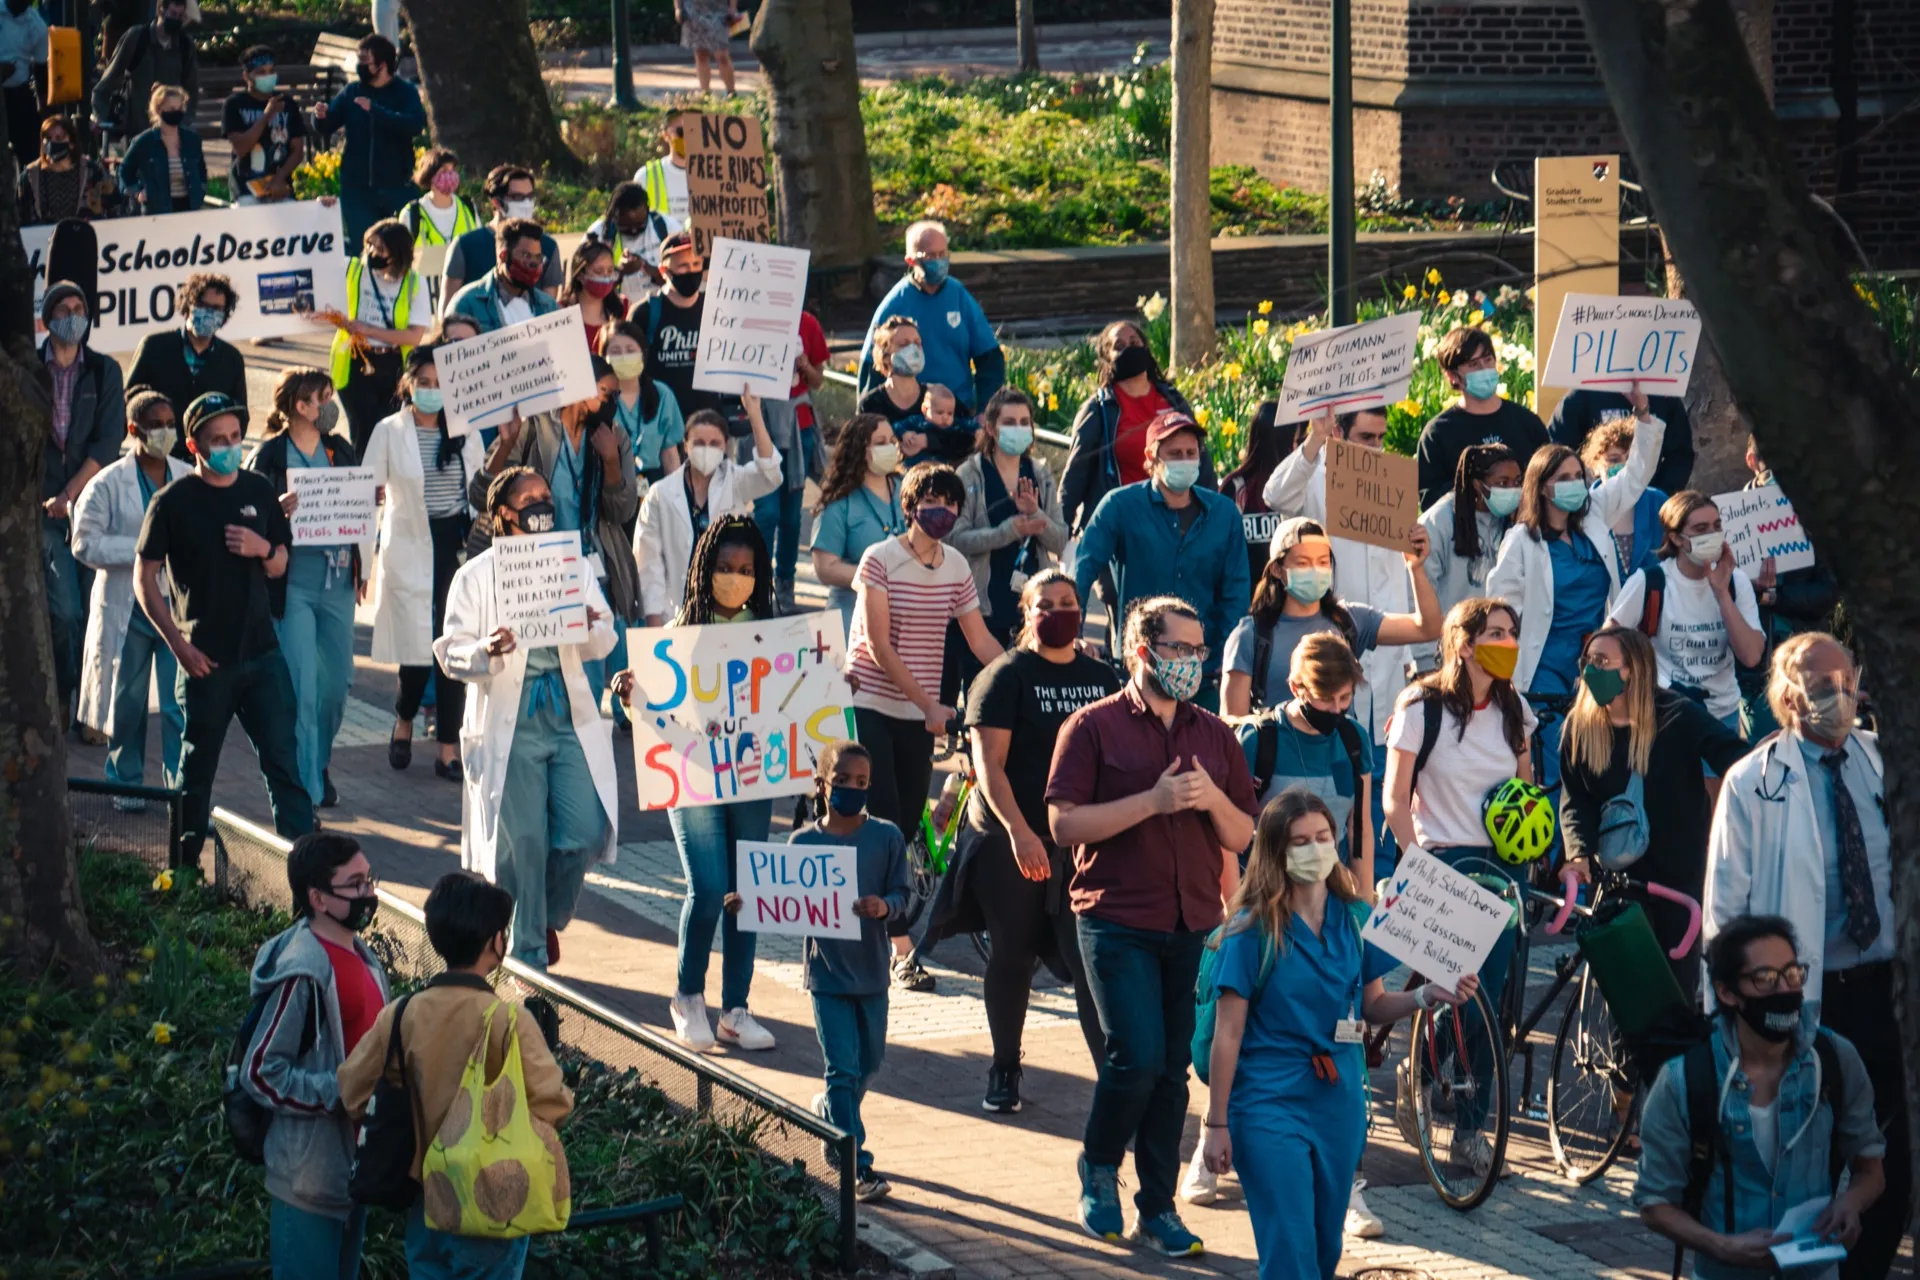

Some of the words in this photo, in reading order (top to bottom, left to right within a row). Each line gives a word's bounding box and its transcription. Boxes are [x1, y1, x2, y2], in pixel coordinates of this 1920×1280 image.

[700, 115, 747, 150] NO
[688, 154, 723, 180] FREE
[728, 156, 766, 189] RIDES
[1546, 187, 1581, 196] Graduate
[1546, 196, 1575, 206] Student
[1577, 196, 1602, 205] Center
[723, 247, 761, 274] It's
[715, 276, 761, 305] time
[712, 306, 738, 329] for
[458, 360, 491, 380] CLEAN
[500, 350, 518, 364] AIR
[1293, 345, 1320, 368] AMY
[1297, 363, 1343, 382] STUDENTS
[1381, 344, 1406, 361] WAIT!
[462, 380, 487, 396] SAFE
[493, 356, 555, 384] CLASSROOMS
[1286, 390, 1300, 403] WE
[1306, 379, 1331, 397] NEED
[1381, 357, 1406, 377] NOW!
[463, 391, 503, 412] HEALTHY
[511, 370, 568, 396] BUILDINGS
[1356, 477, 1404, 511] PHILLY
[1720, 495, 1771, 523] Students
[500, 540, 535, 555] PHILLY
[499, 557, 560, 573] STUDENTS
[502, 577, 533, 590] NEED
[540, 573, 566, 586] SAFE
[517, 589, 562, 605] HEALTHY
[506, 609, 546, 621] SCHOOLS
[509, 613, 565, 640] NOW!
[1034, 685, 1057, 699] THE
[1061, 685, 1105, 699] FUTURE
[1041, 700, 1052, 713] IS
[1057, 700, 1096, 713] FEM
[756, 890, 841, 930] NOW!
[1405, 885, 1435, 908] Clean
[1436, 903, 1454, 917] Air
[1396, 902, 1417, 921] Safe
[1423, 917, 1477, 953] Classrooms
[1382, 919, 1419, 953] Healthy
[1424, 940, 1464, 974] Buildings
